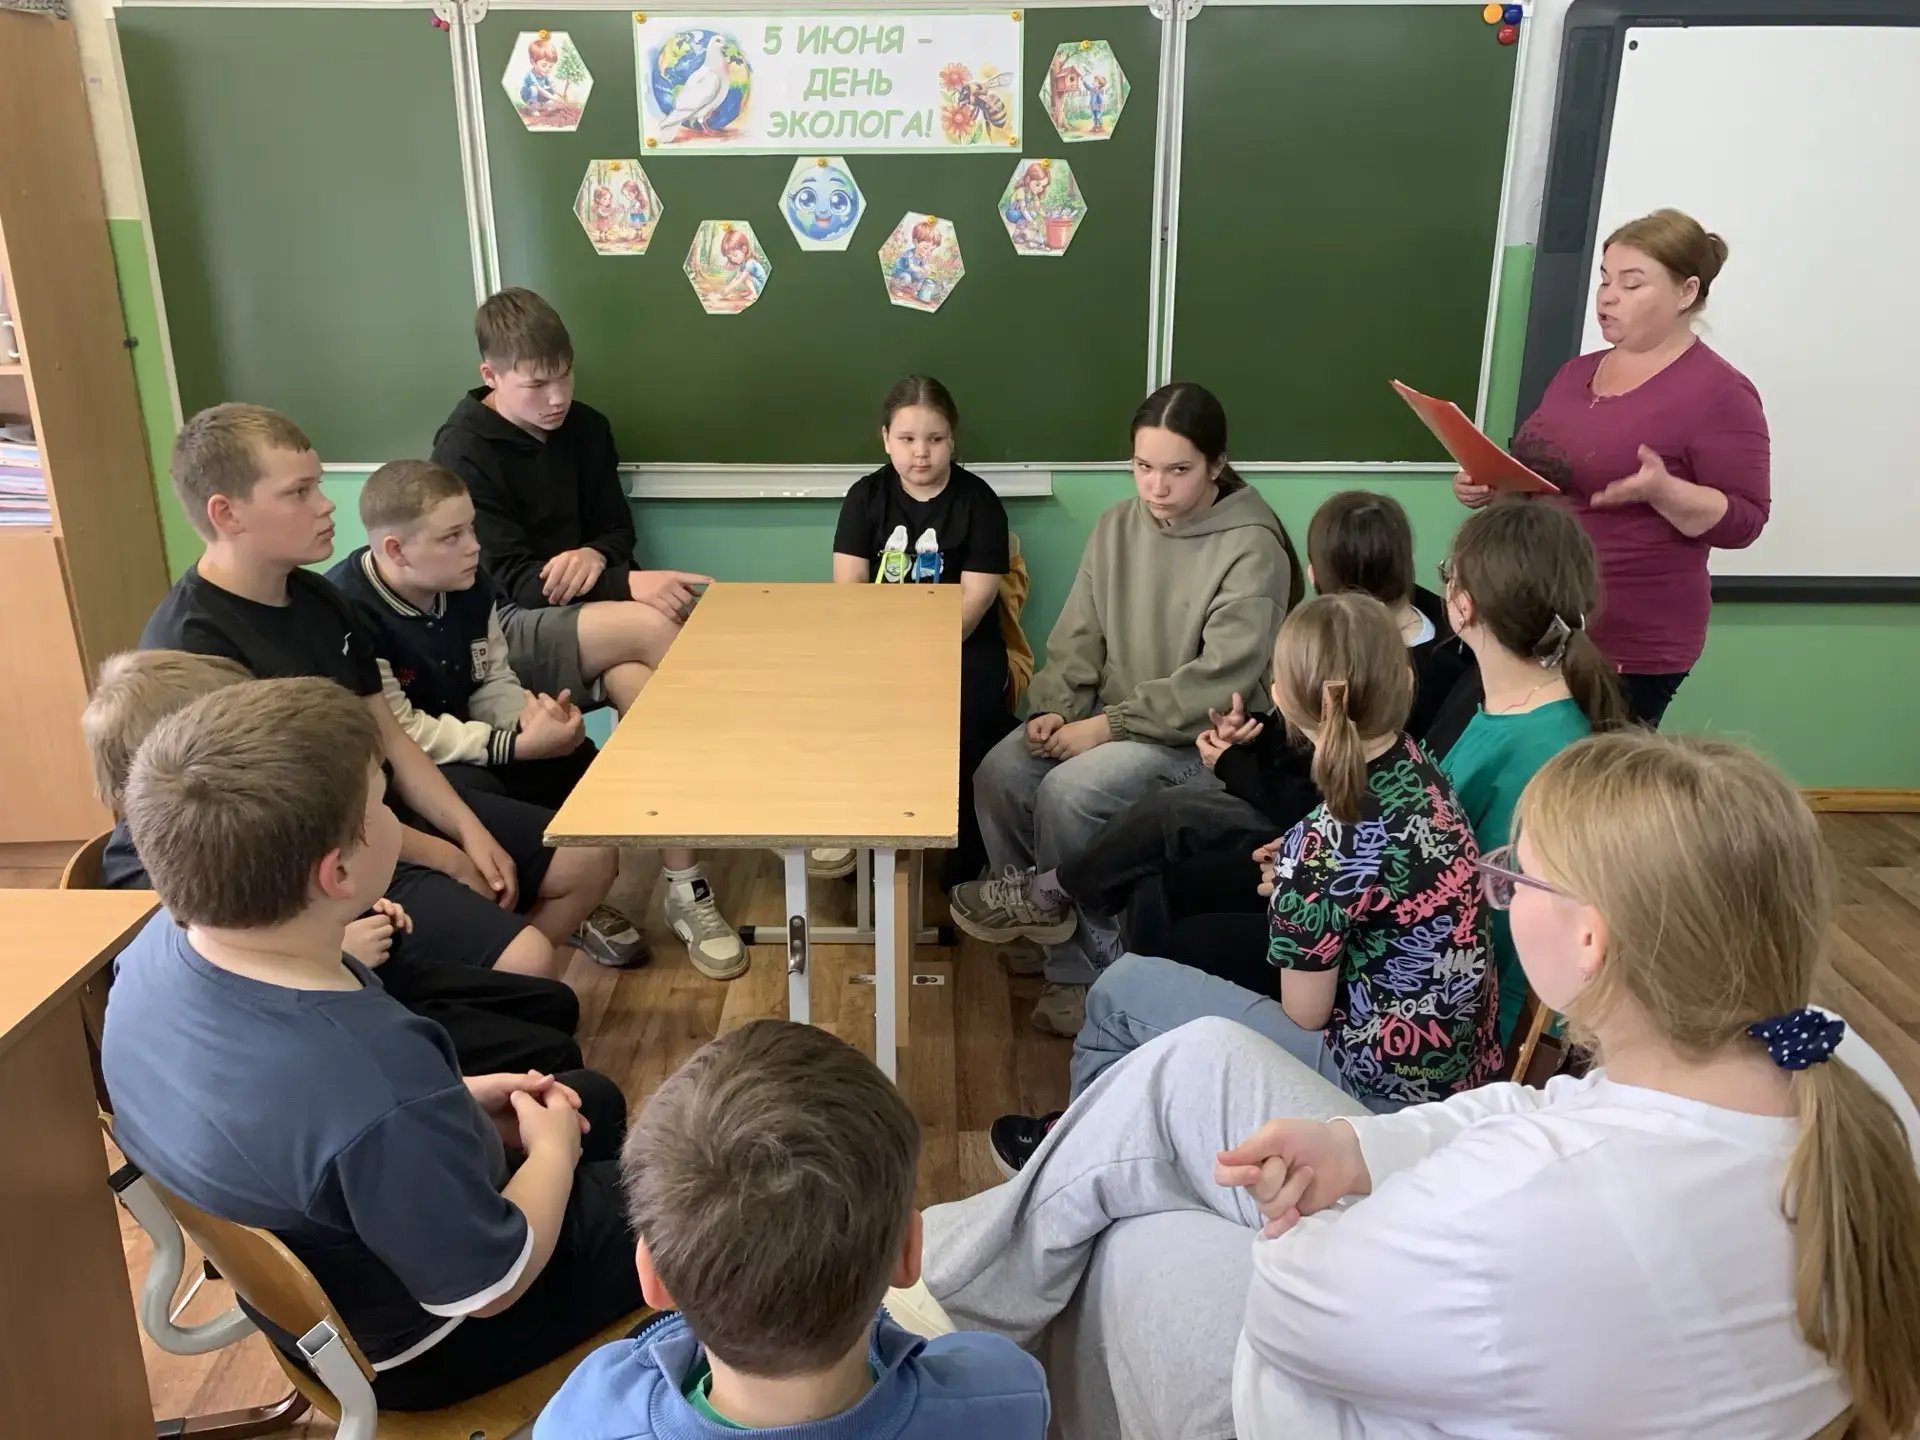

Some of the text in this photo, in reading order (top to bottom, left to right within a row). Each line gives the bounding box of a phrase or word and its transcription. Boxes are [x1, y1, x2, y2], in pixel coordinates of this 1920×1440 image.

[762, 25, 783, 55] 5
[796, 24, 905, 55] ИЮНЯ
[802, 66, 893, 101] ДЕНЬ
[766, 108, 934, 139] ЭКОЛОГА!
